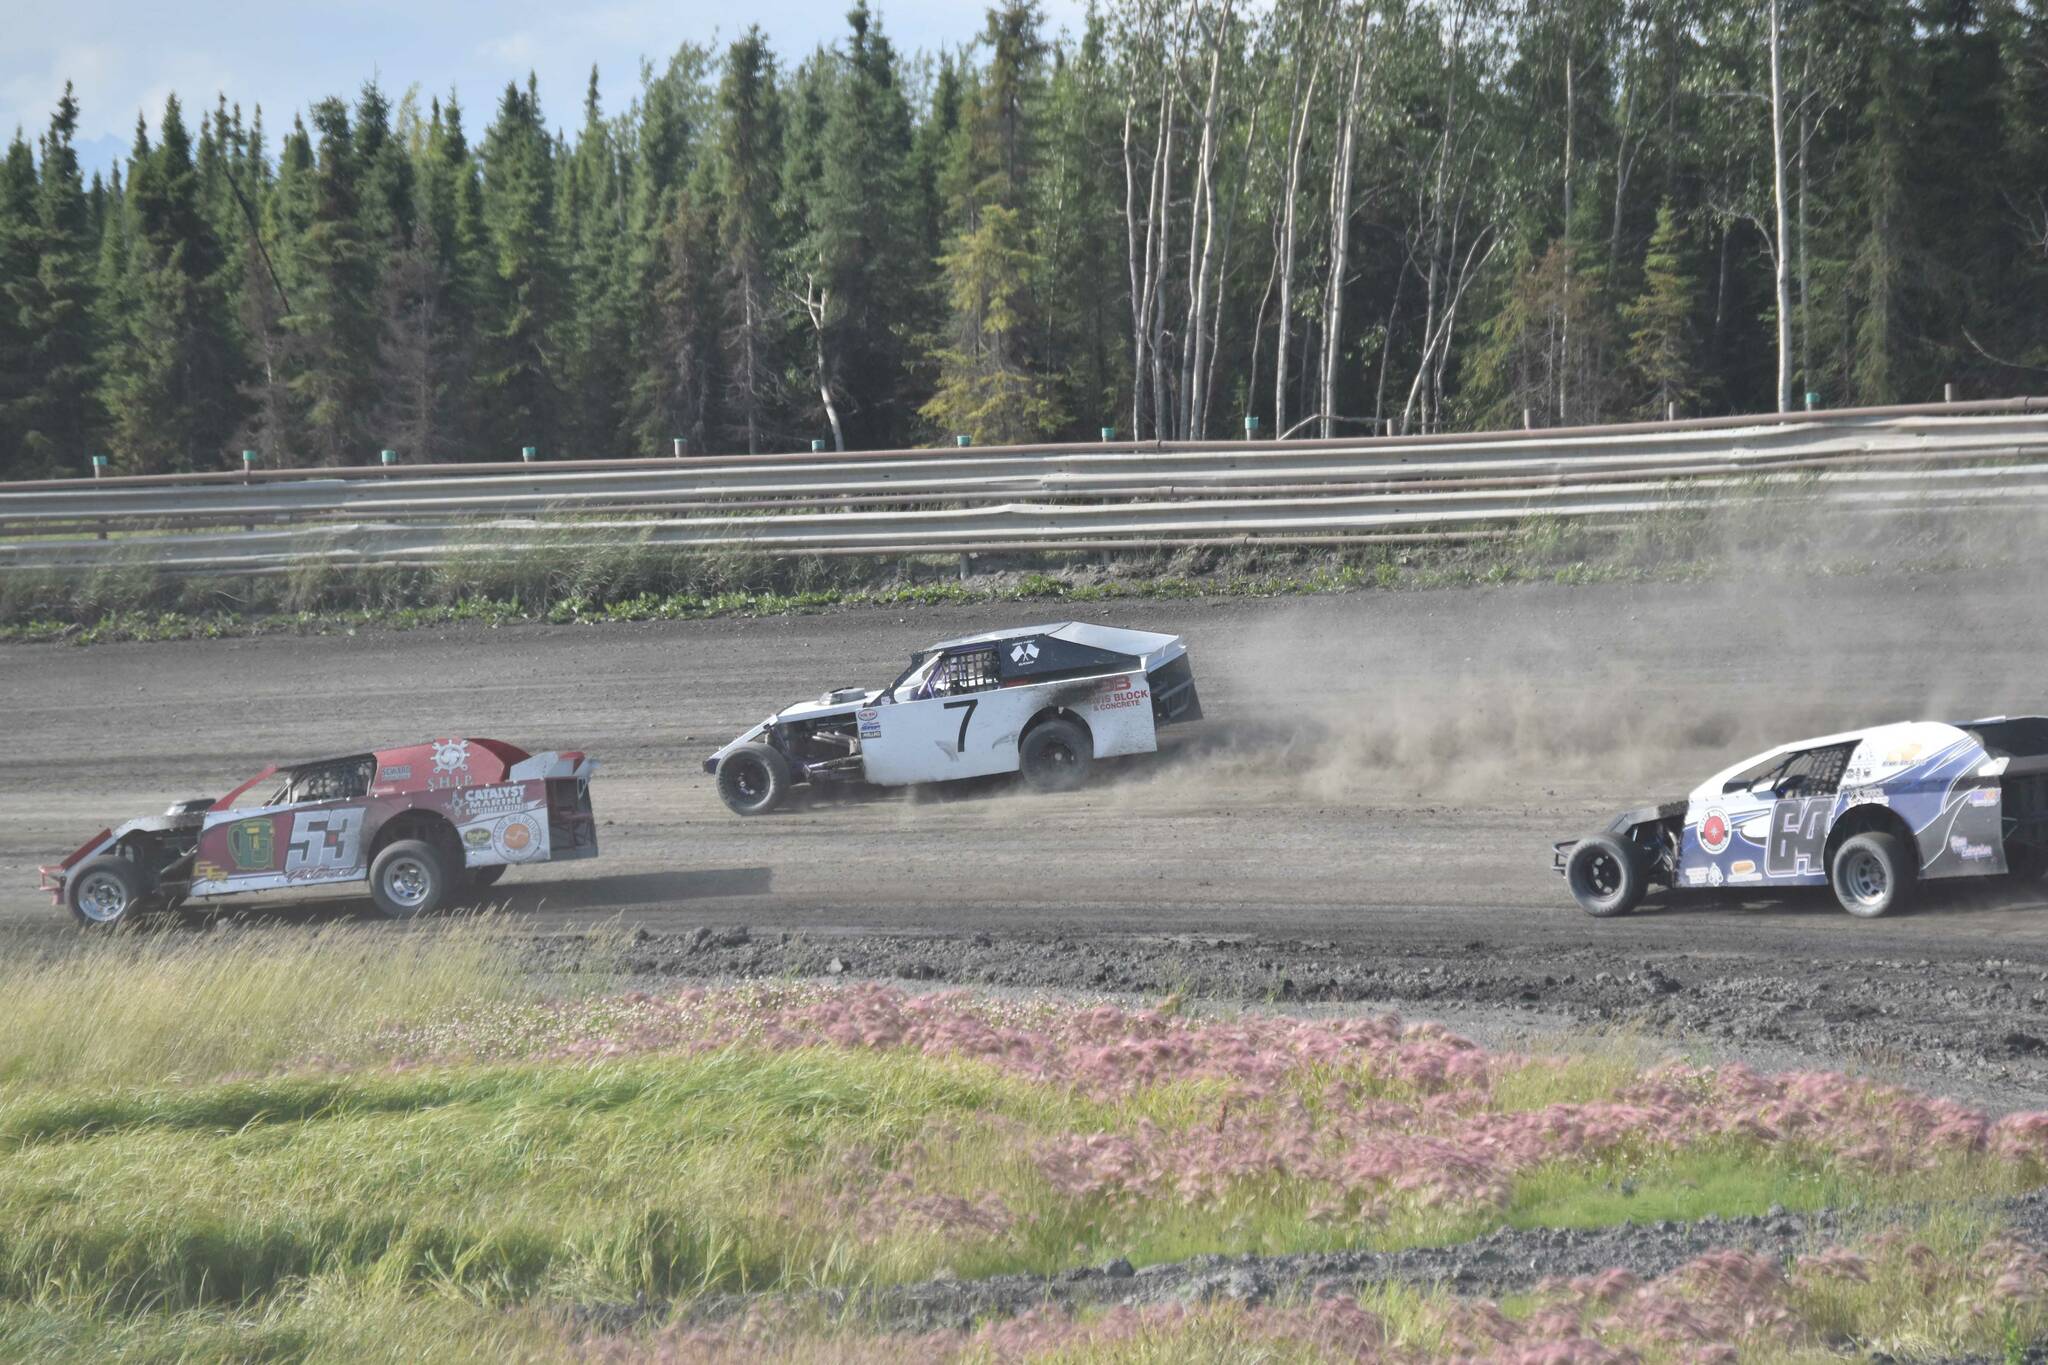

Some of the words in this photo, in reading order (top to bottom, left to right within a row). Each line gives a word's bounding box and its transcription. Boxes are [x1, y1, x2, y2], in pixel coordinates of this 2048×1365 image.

[1114, 690, 1148, 701] BLOCK
[1100, 700, 1141, 711] CONCRETE
[944, 699, 978, 753] 7
[465, 785, 526, 800] CATALYST
[469, 798, 523, 808] MARINE
[286, 807, 366, 872] 53
[1765, 795, 1834, 878] 64
